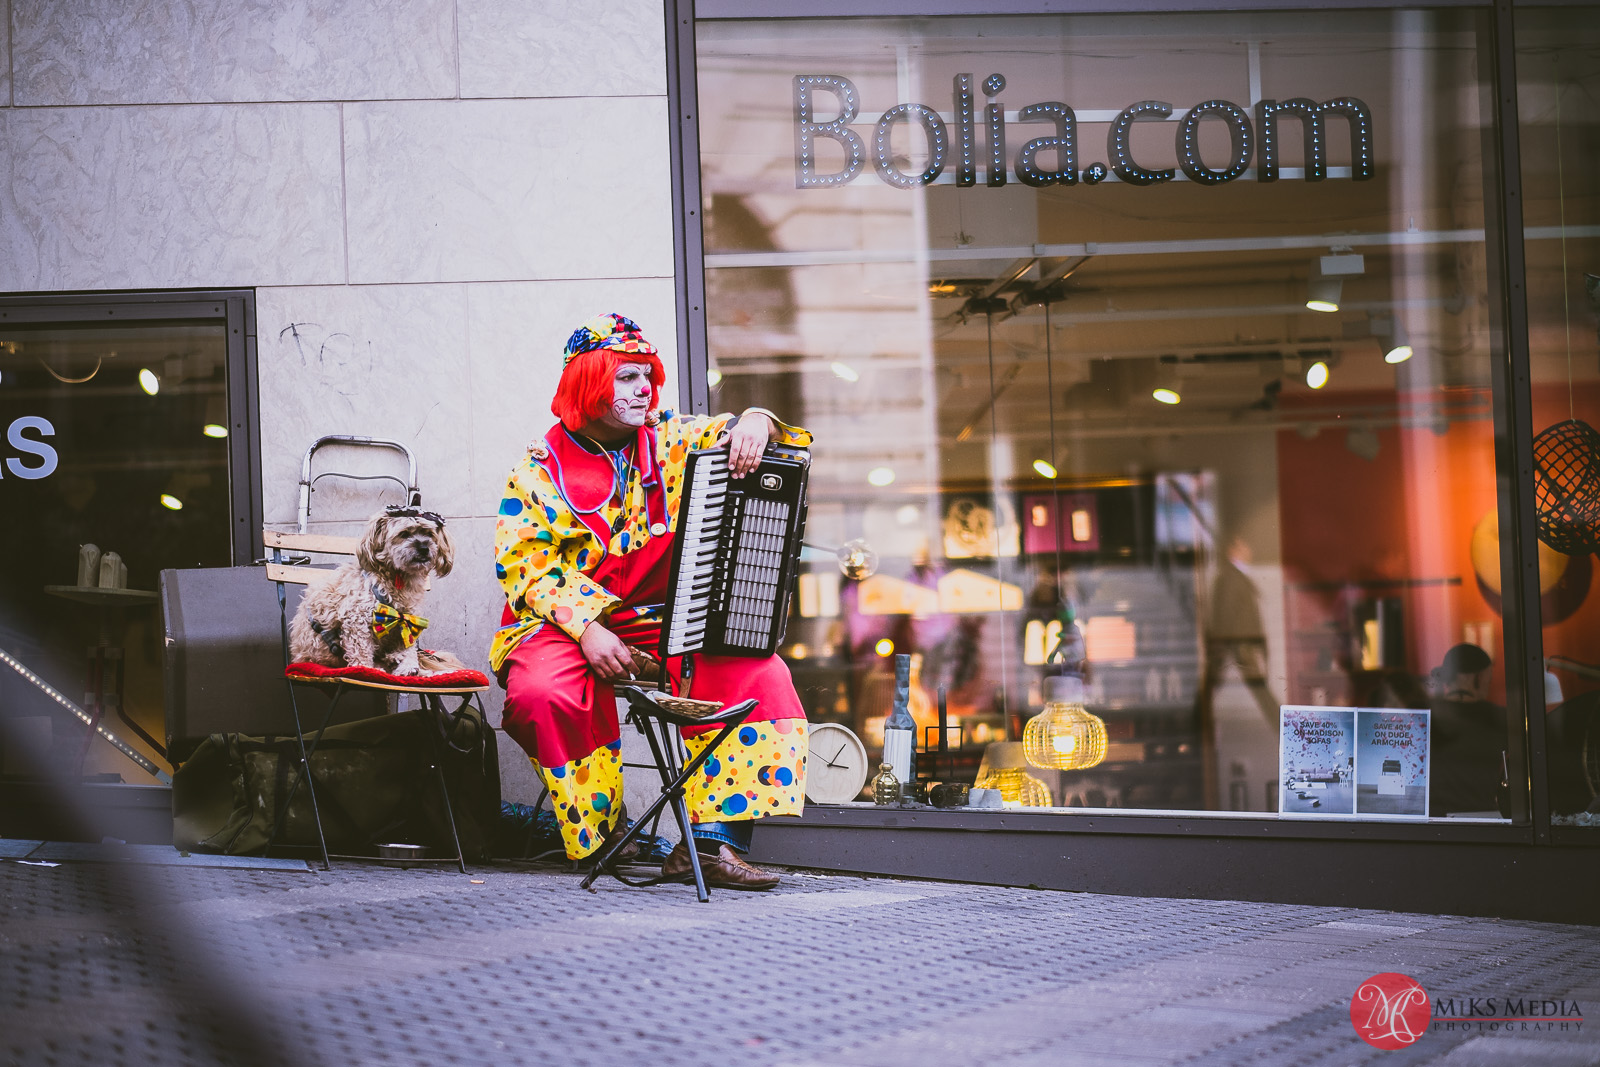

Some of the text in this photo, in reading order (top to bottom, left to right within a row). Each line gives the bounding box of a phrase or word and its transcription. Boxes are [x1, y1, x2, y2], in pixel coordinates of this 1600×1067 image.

[792, 73, 1374, 189] Bolia.com
[0, 416, 58, 480] s
[1300, 721, 1321, 729] SAVE
[1293, 728, 1344, 737] ON MADISON
[1374, 730, 1410, 739] ON DUDE
